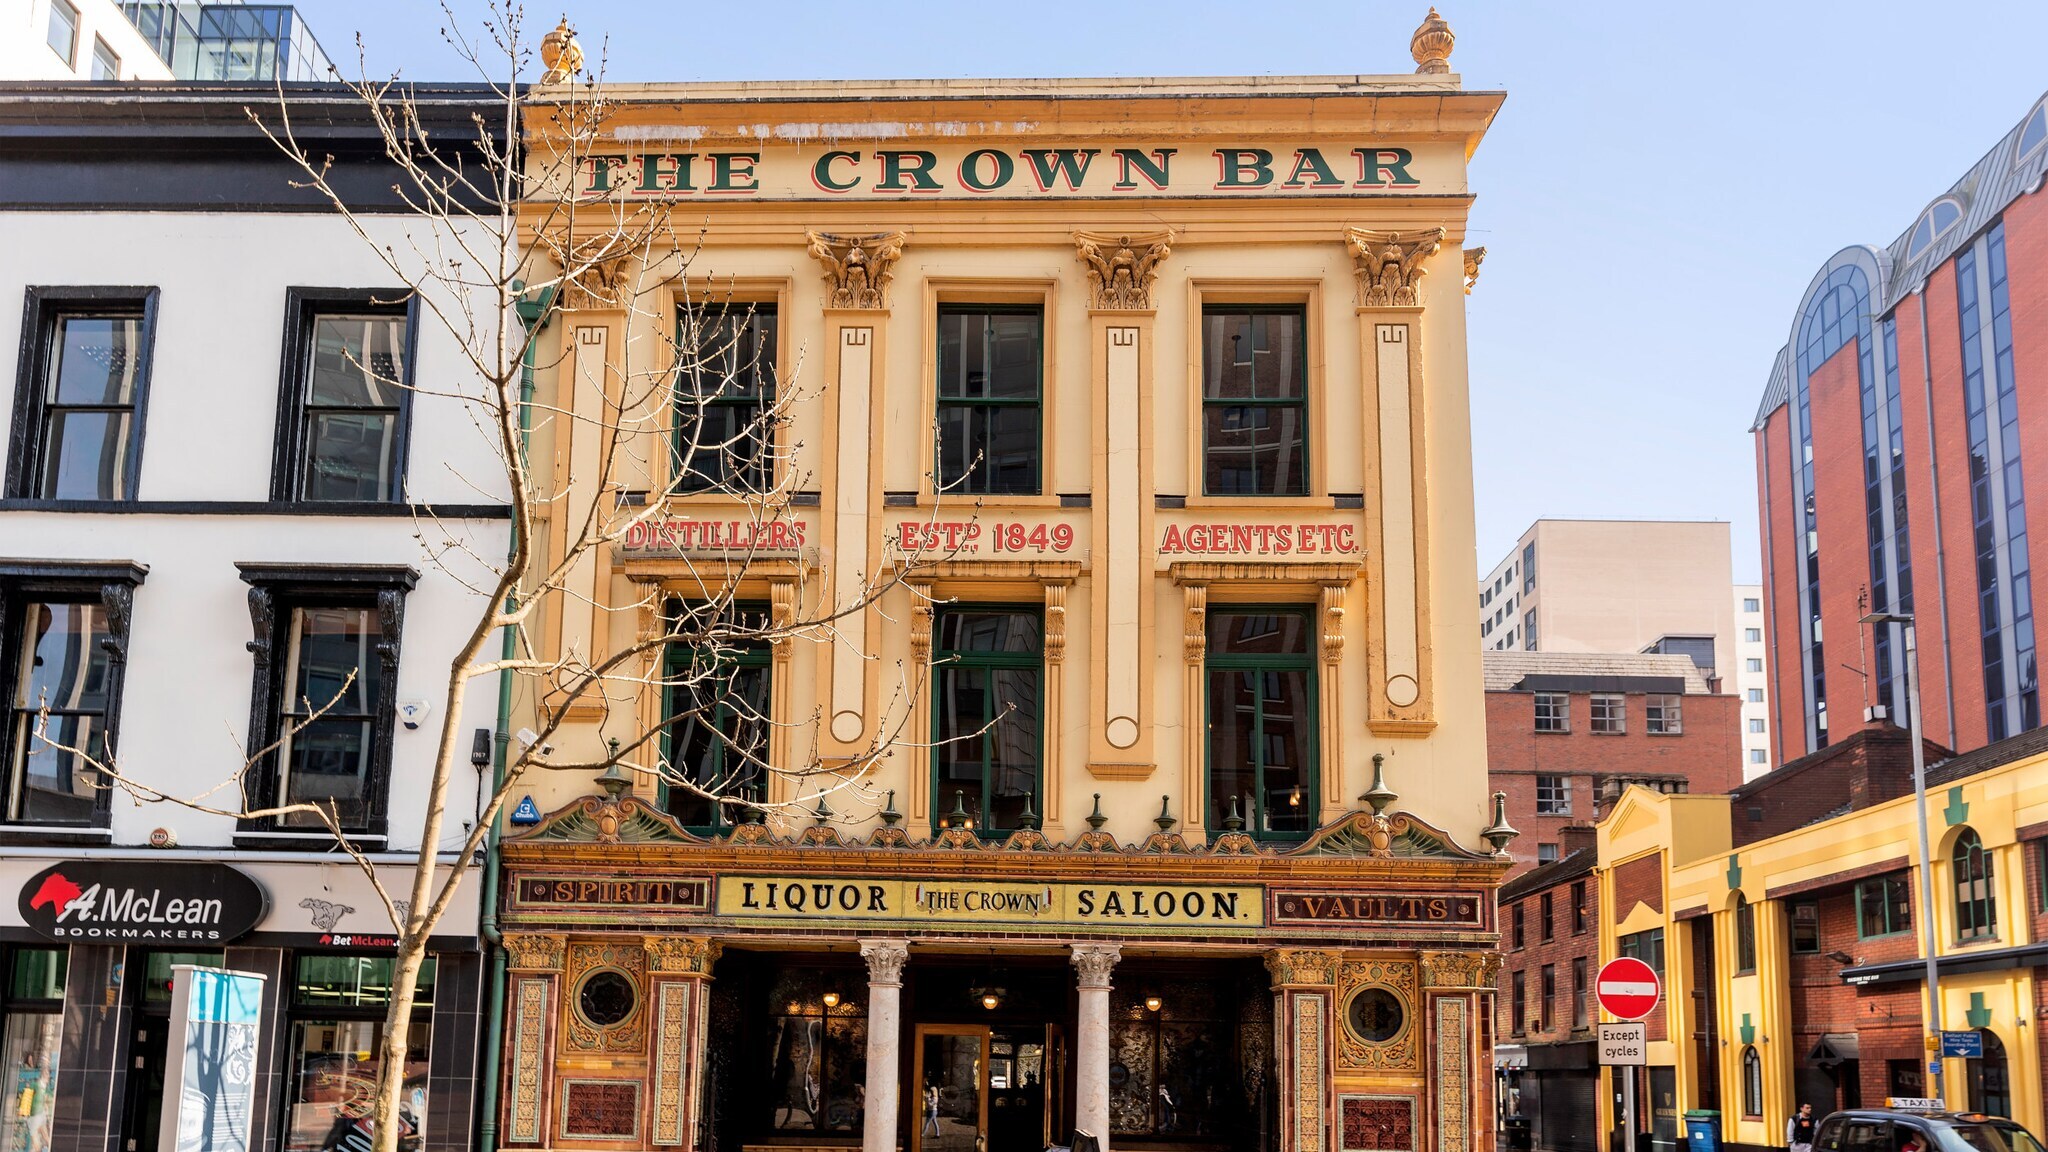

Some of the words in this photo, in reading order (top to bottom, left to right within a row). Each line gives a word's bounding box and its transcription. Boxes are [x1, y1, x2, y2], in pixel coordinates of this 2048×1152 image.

[577, 152, 761, 196] THE
[811, 148, 1178, 194] CROWN
[1212, 147, 1421, 191] BAR
[622, 520, 807, 551] DISTILLERS
[993, 522, 1075, 554] 1849
[1159, 523, 1293, 555] AGENTS
[554, 881, 671, 903] SPIRIT
[742, 882, 889, 913] LIQUOR
[926, 890, 960, 912] THE
[964, 890, 1041, 914] CROWN
[1302, 896, 1449, 920] VAULTS
[54, 927, 221, 940] BOOKMAKERS
[332, 934, 401, 947] BetMcLean.c
[1603, 1030, 1639, 1041] Except
[1605, 1046, 1638, 1057] cycles
[1901, 1099, 1928, 1107] TAXI
